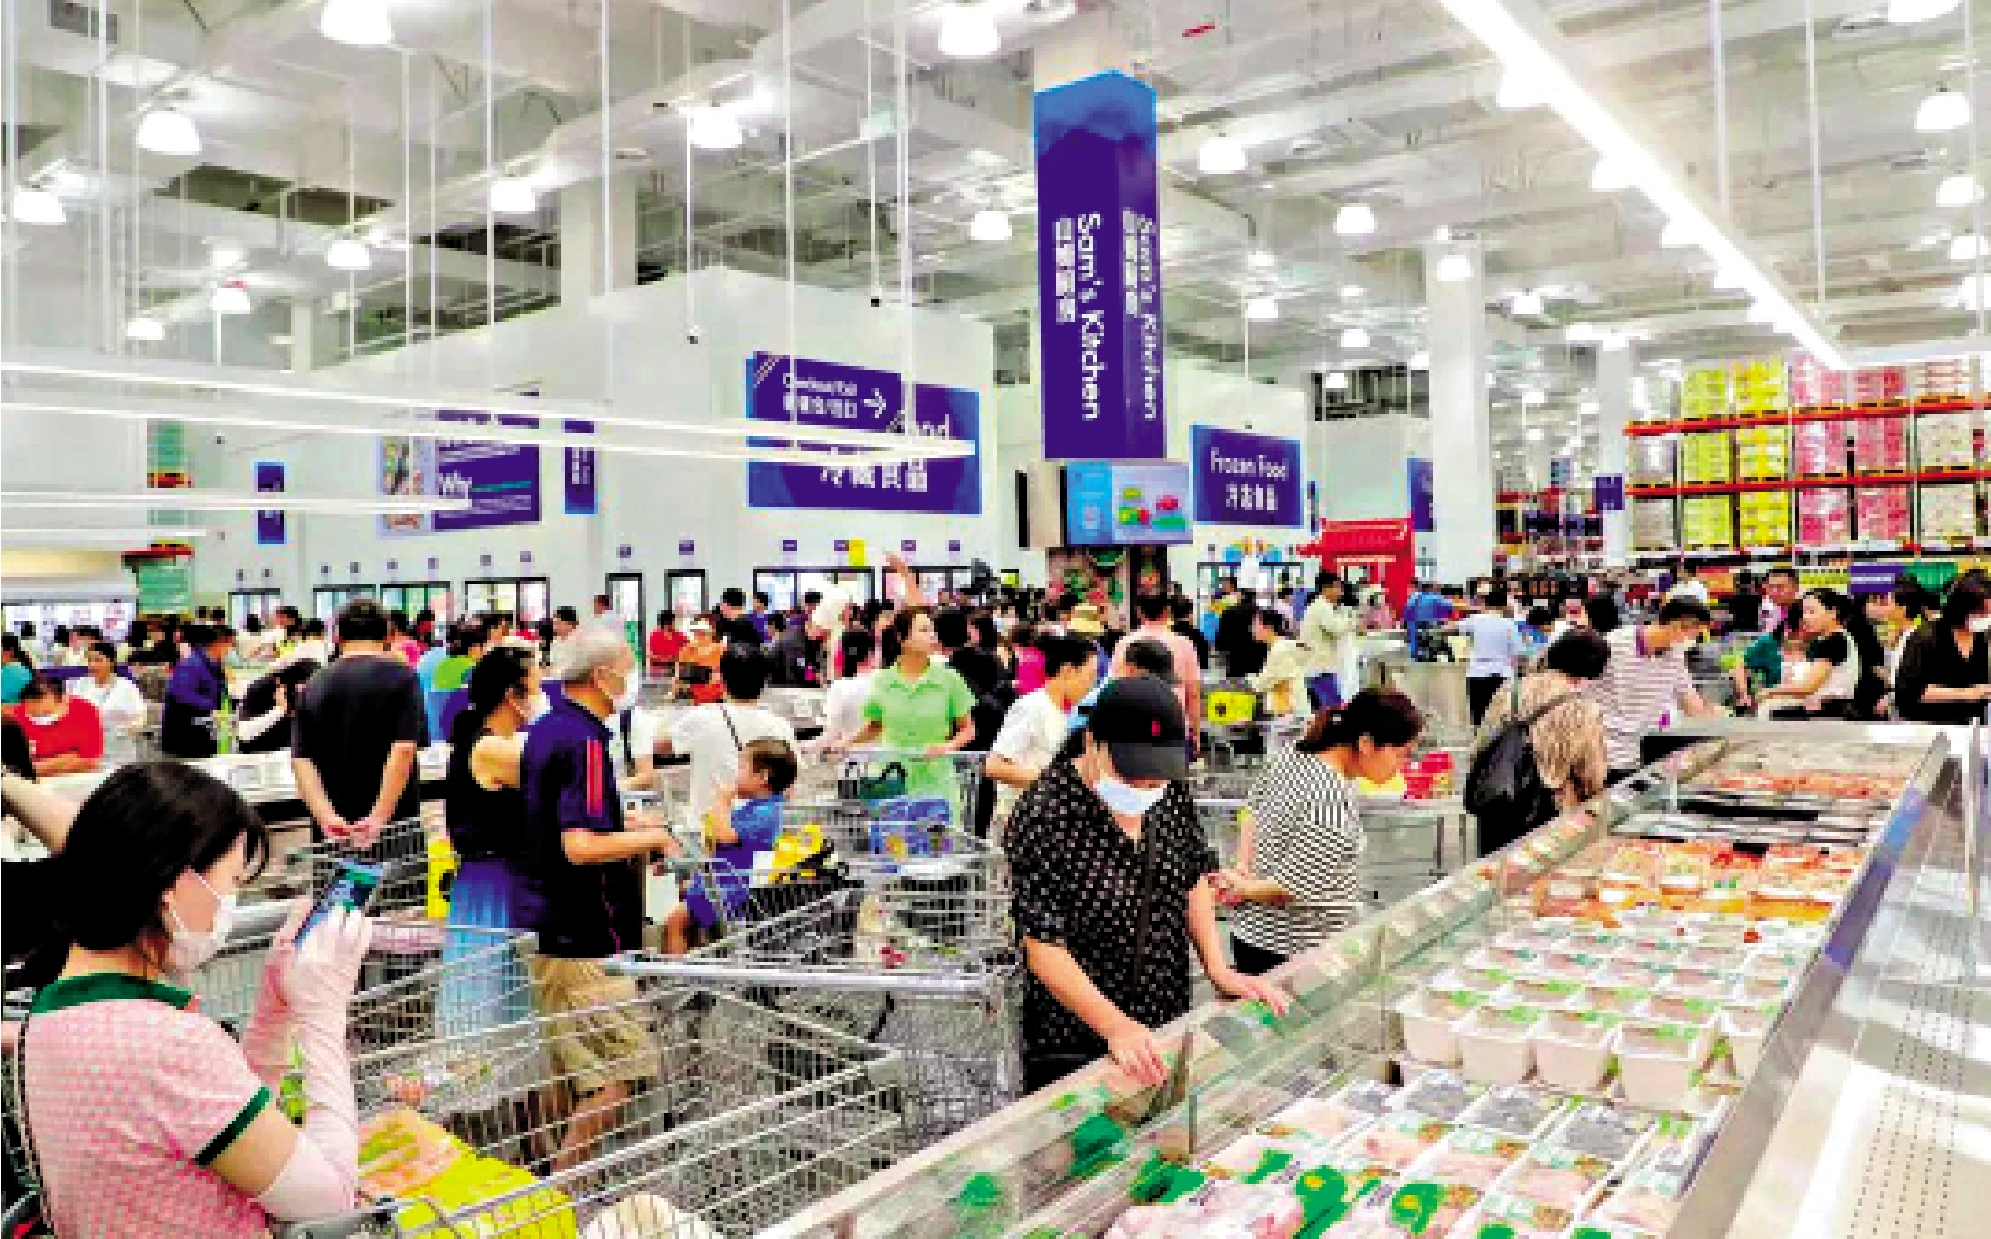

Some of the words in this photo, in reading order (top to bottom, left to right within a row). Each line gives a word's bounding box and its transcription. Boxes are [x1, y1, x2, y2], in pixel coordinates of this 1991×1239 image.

[1077, 211, 1105, 303] Sam's
[1081, 310, 1108, 421] Kitchen
[1210, 446, 1257, 477] Frozen
[1257, 454, 1289, 482] Food
